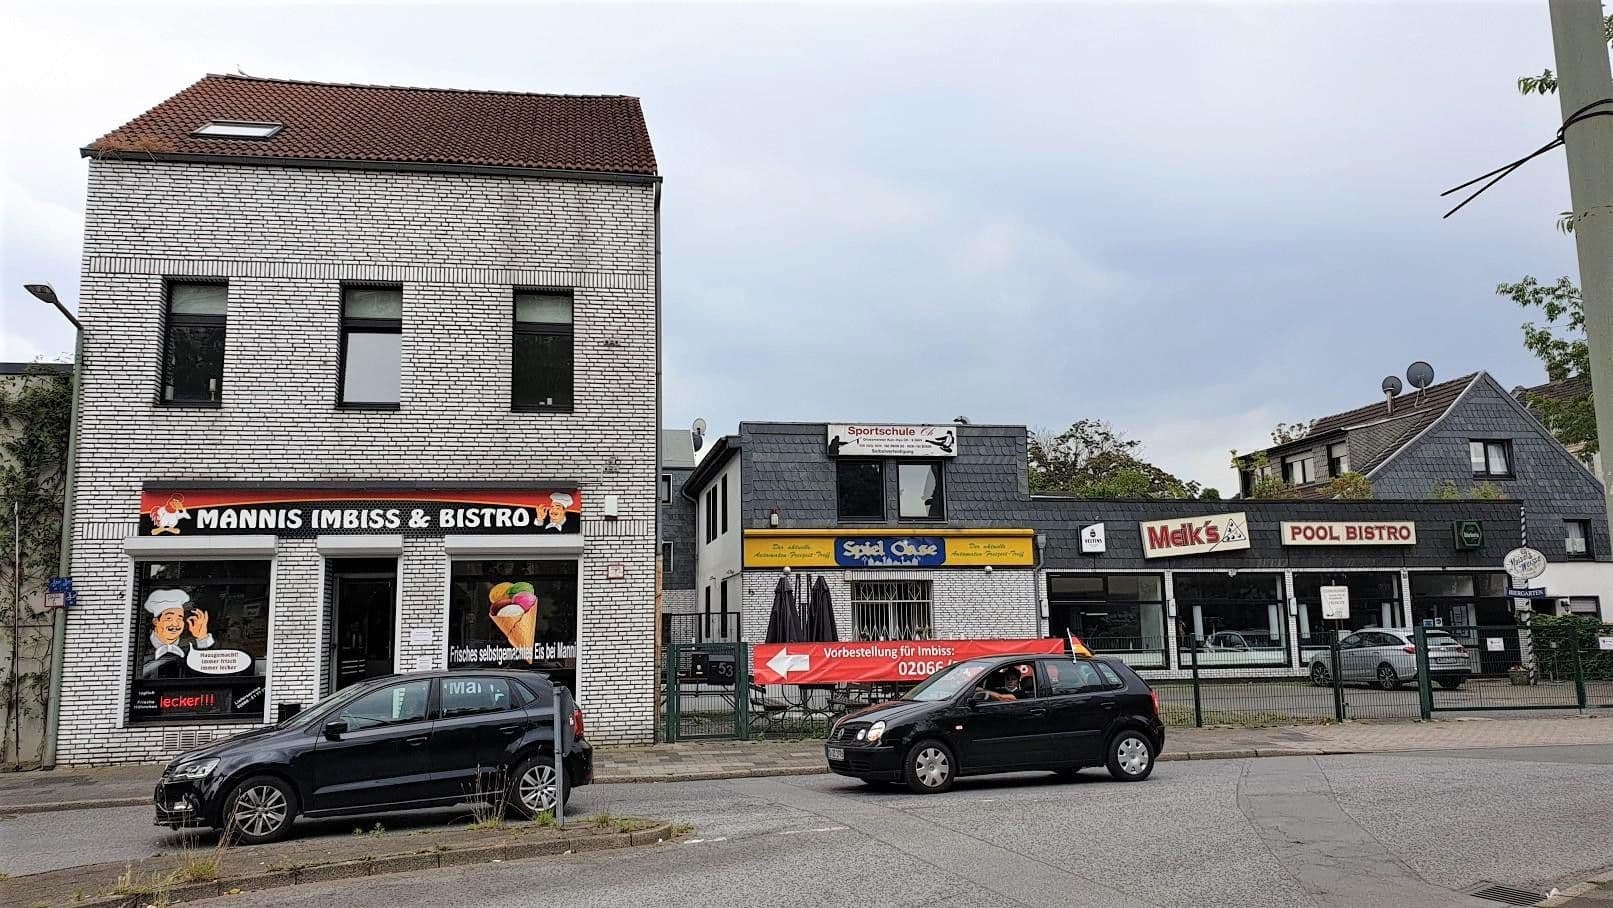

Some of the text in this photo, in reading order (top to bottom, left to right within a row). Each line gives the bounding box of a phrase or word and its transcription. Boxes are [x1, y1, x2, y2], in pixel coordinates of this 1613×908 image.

[847, 426, 916, 437] Sportschule
[196, 508, 530, 529] MANNIS IMBISS & BISTRO
[1290, 525, 1412, 541] POOL BISTRO
[842, 540, 885, 559] Spiel
[449, 645, 479, 663] Frisches
[534, 642, 545, 660] Eis
[545, 641, 556, 660] bei
[823, 646, 955, 660] Vorbestellung für Imbiss:
[160, 693, 214, 708] lecker!!!
